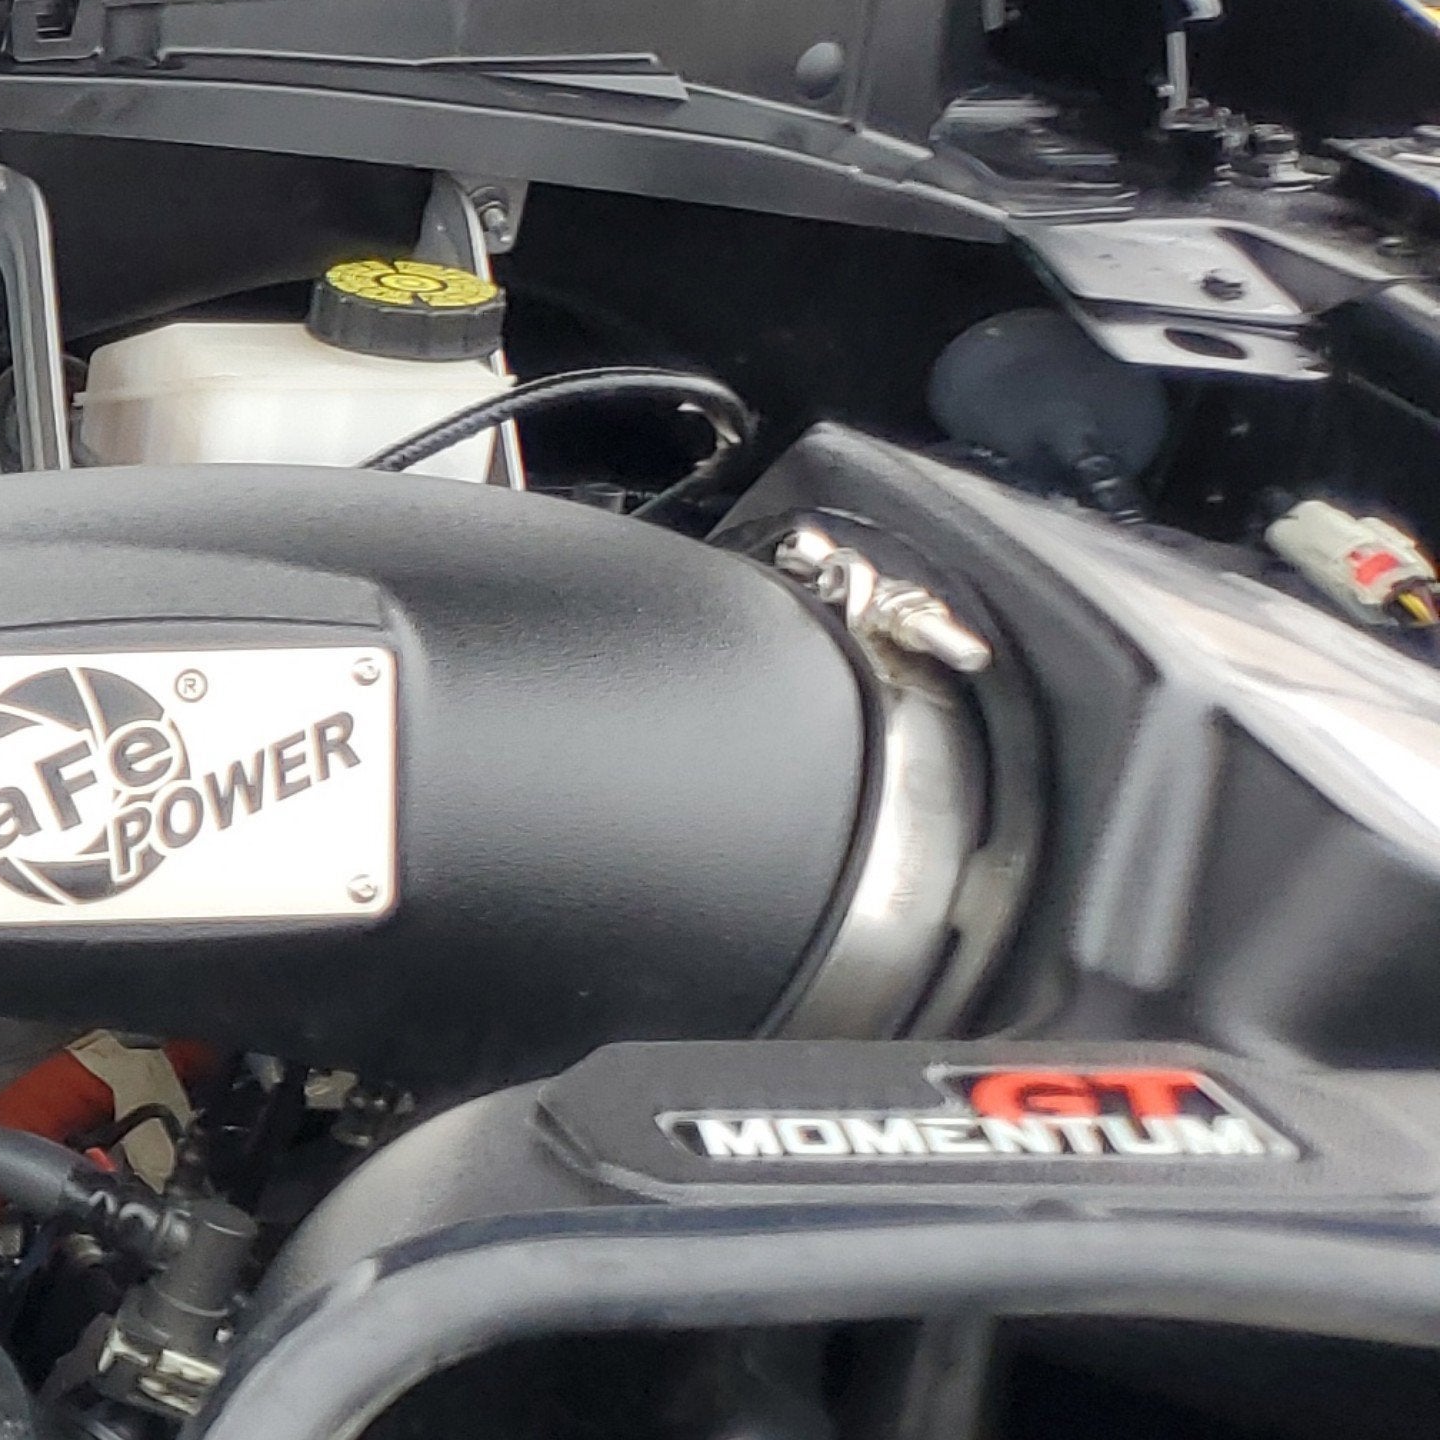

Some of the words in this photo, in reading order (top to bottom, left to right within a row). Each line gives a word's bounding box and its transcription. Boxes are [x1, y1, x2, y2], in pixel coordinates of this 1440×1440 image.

[110, 709, 363, 877] POWER
[969, 1070, 1202, 1121] GT
[696, 1116, 1266, 1157] MOMENTUM
